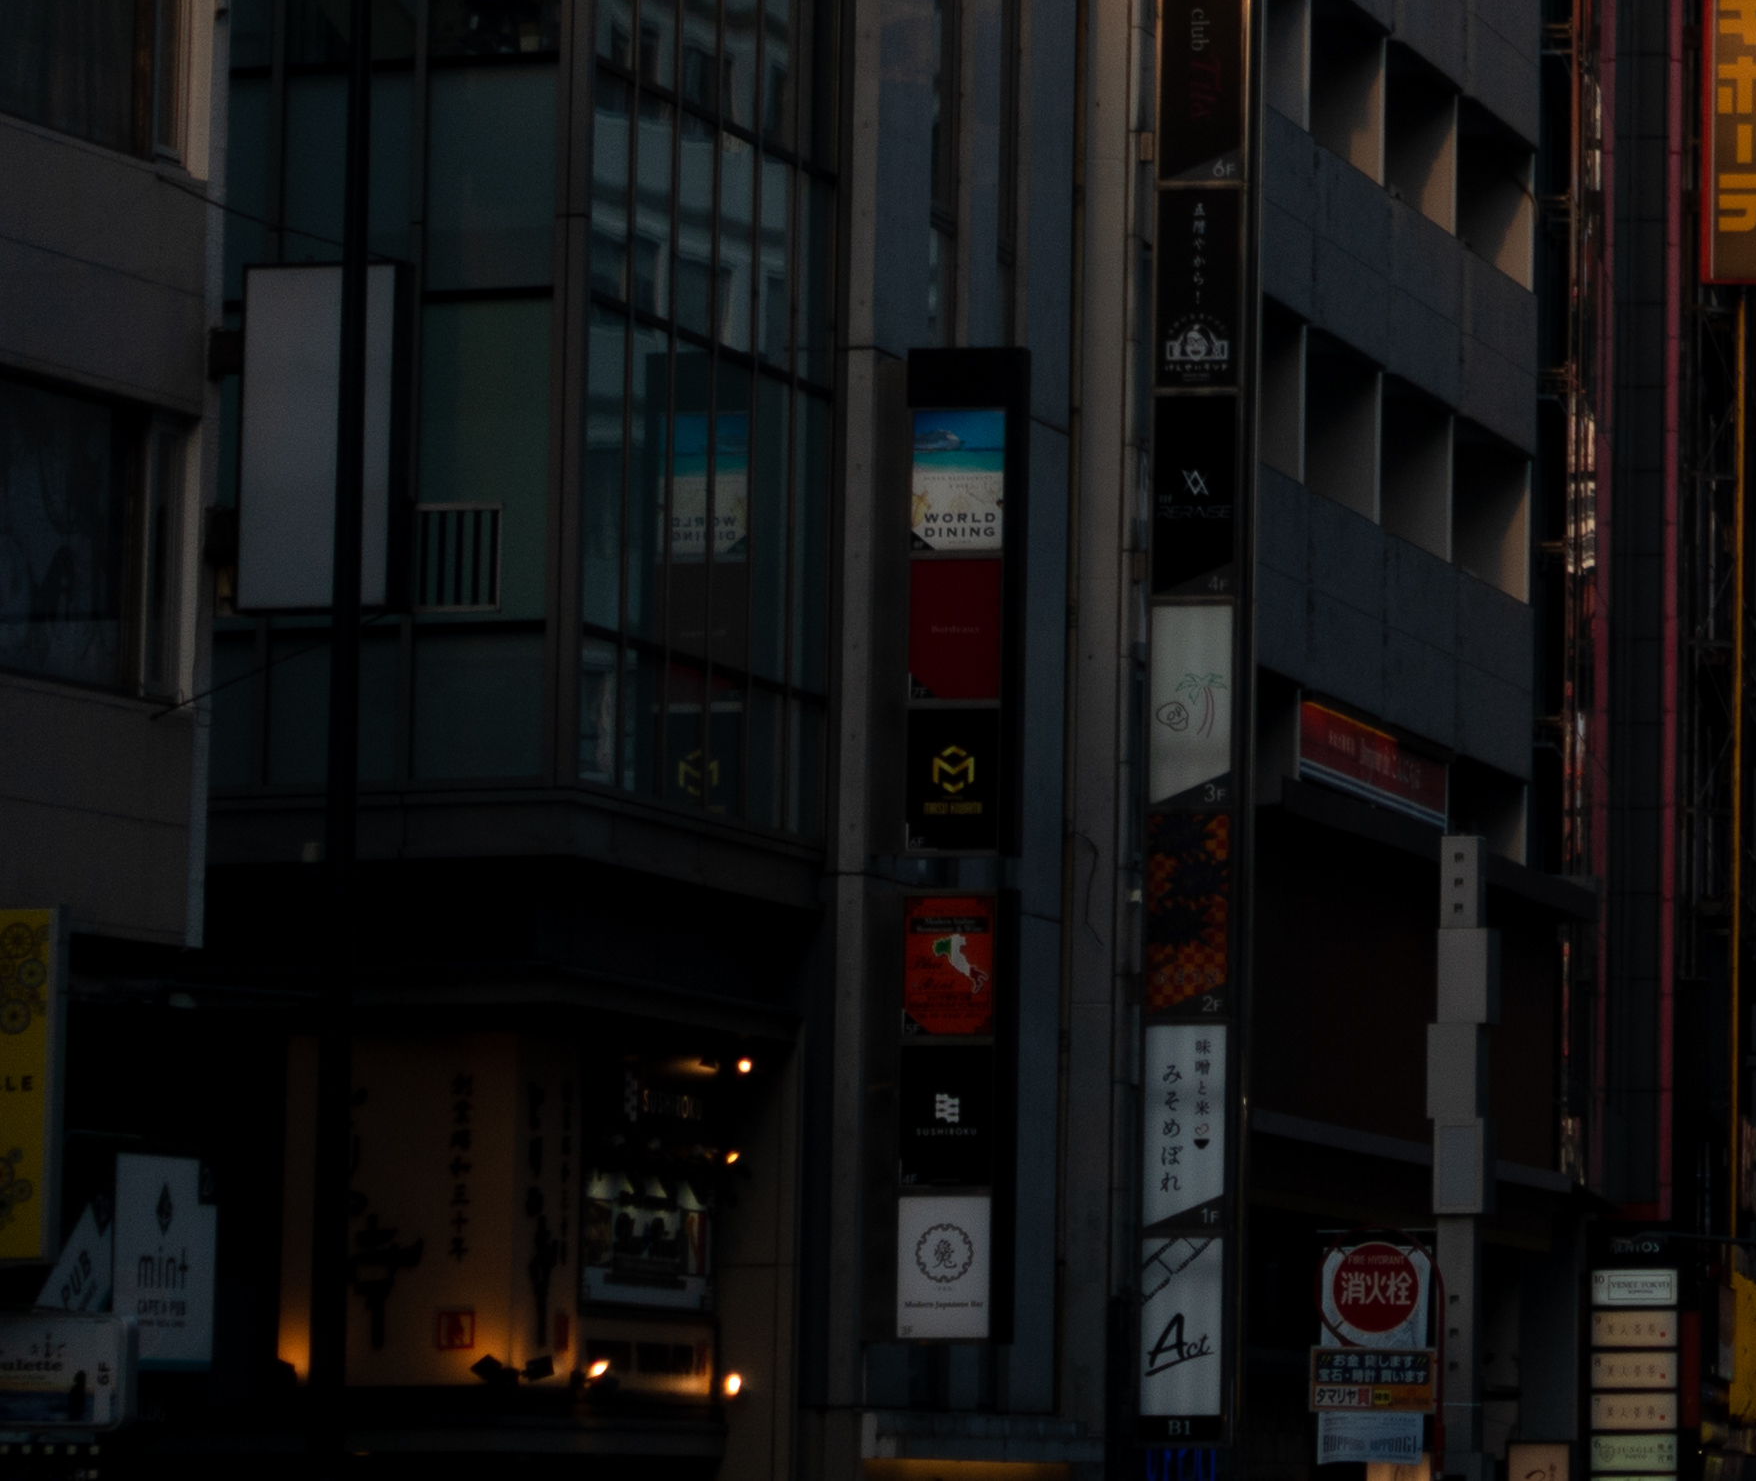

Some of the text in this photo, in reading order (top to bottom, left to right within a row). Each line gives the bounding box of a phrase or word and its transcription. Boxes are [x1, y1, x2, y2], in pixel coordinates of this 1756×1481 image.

[1190, 8, 1210, 52] club
[1212, 158, 1236, 178] 6F
[924, 512, 996, 524] WORLD
[924, 527, 996, 538] DINING
[1208, 575, 1230, 591] 4F
[931, 625, 981, 635] Bordeaux
[1203, 783, 1227, 802] 3F
[1202, 995, 1223, 1013] 2F
[1194, 1038, 1211, 1117] 味噌と米
[641, 1088, 704, 1121] SUSHIROKU
[915, 1127, 978, 1137] SUSHIROKU
[1159, 1064, 1183, 1193] みそめぼれ
[1201, 1207, 1220, 1224] 1F
[137, 1246, 189, 1290] mint
[1347, 1255, 1405, 1265] FIRE HYDRANT
[60, 1250, 92, 1312] PUB
[1340, 1270, 1413, 1306] 消火栓
[904, 1299, 984, 1310] Modern Japanese Bar
[1146, 1312, 1212, 1369] Act
[1318, 1369, 1427, 1383] 宝石・時計 買います
[1166, 1419, 1192, 1437] B1
